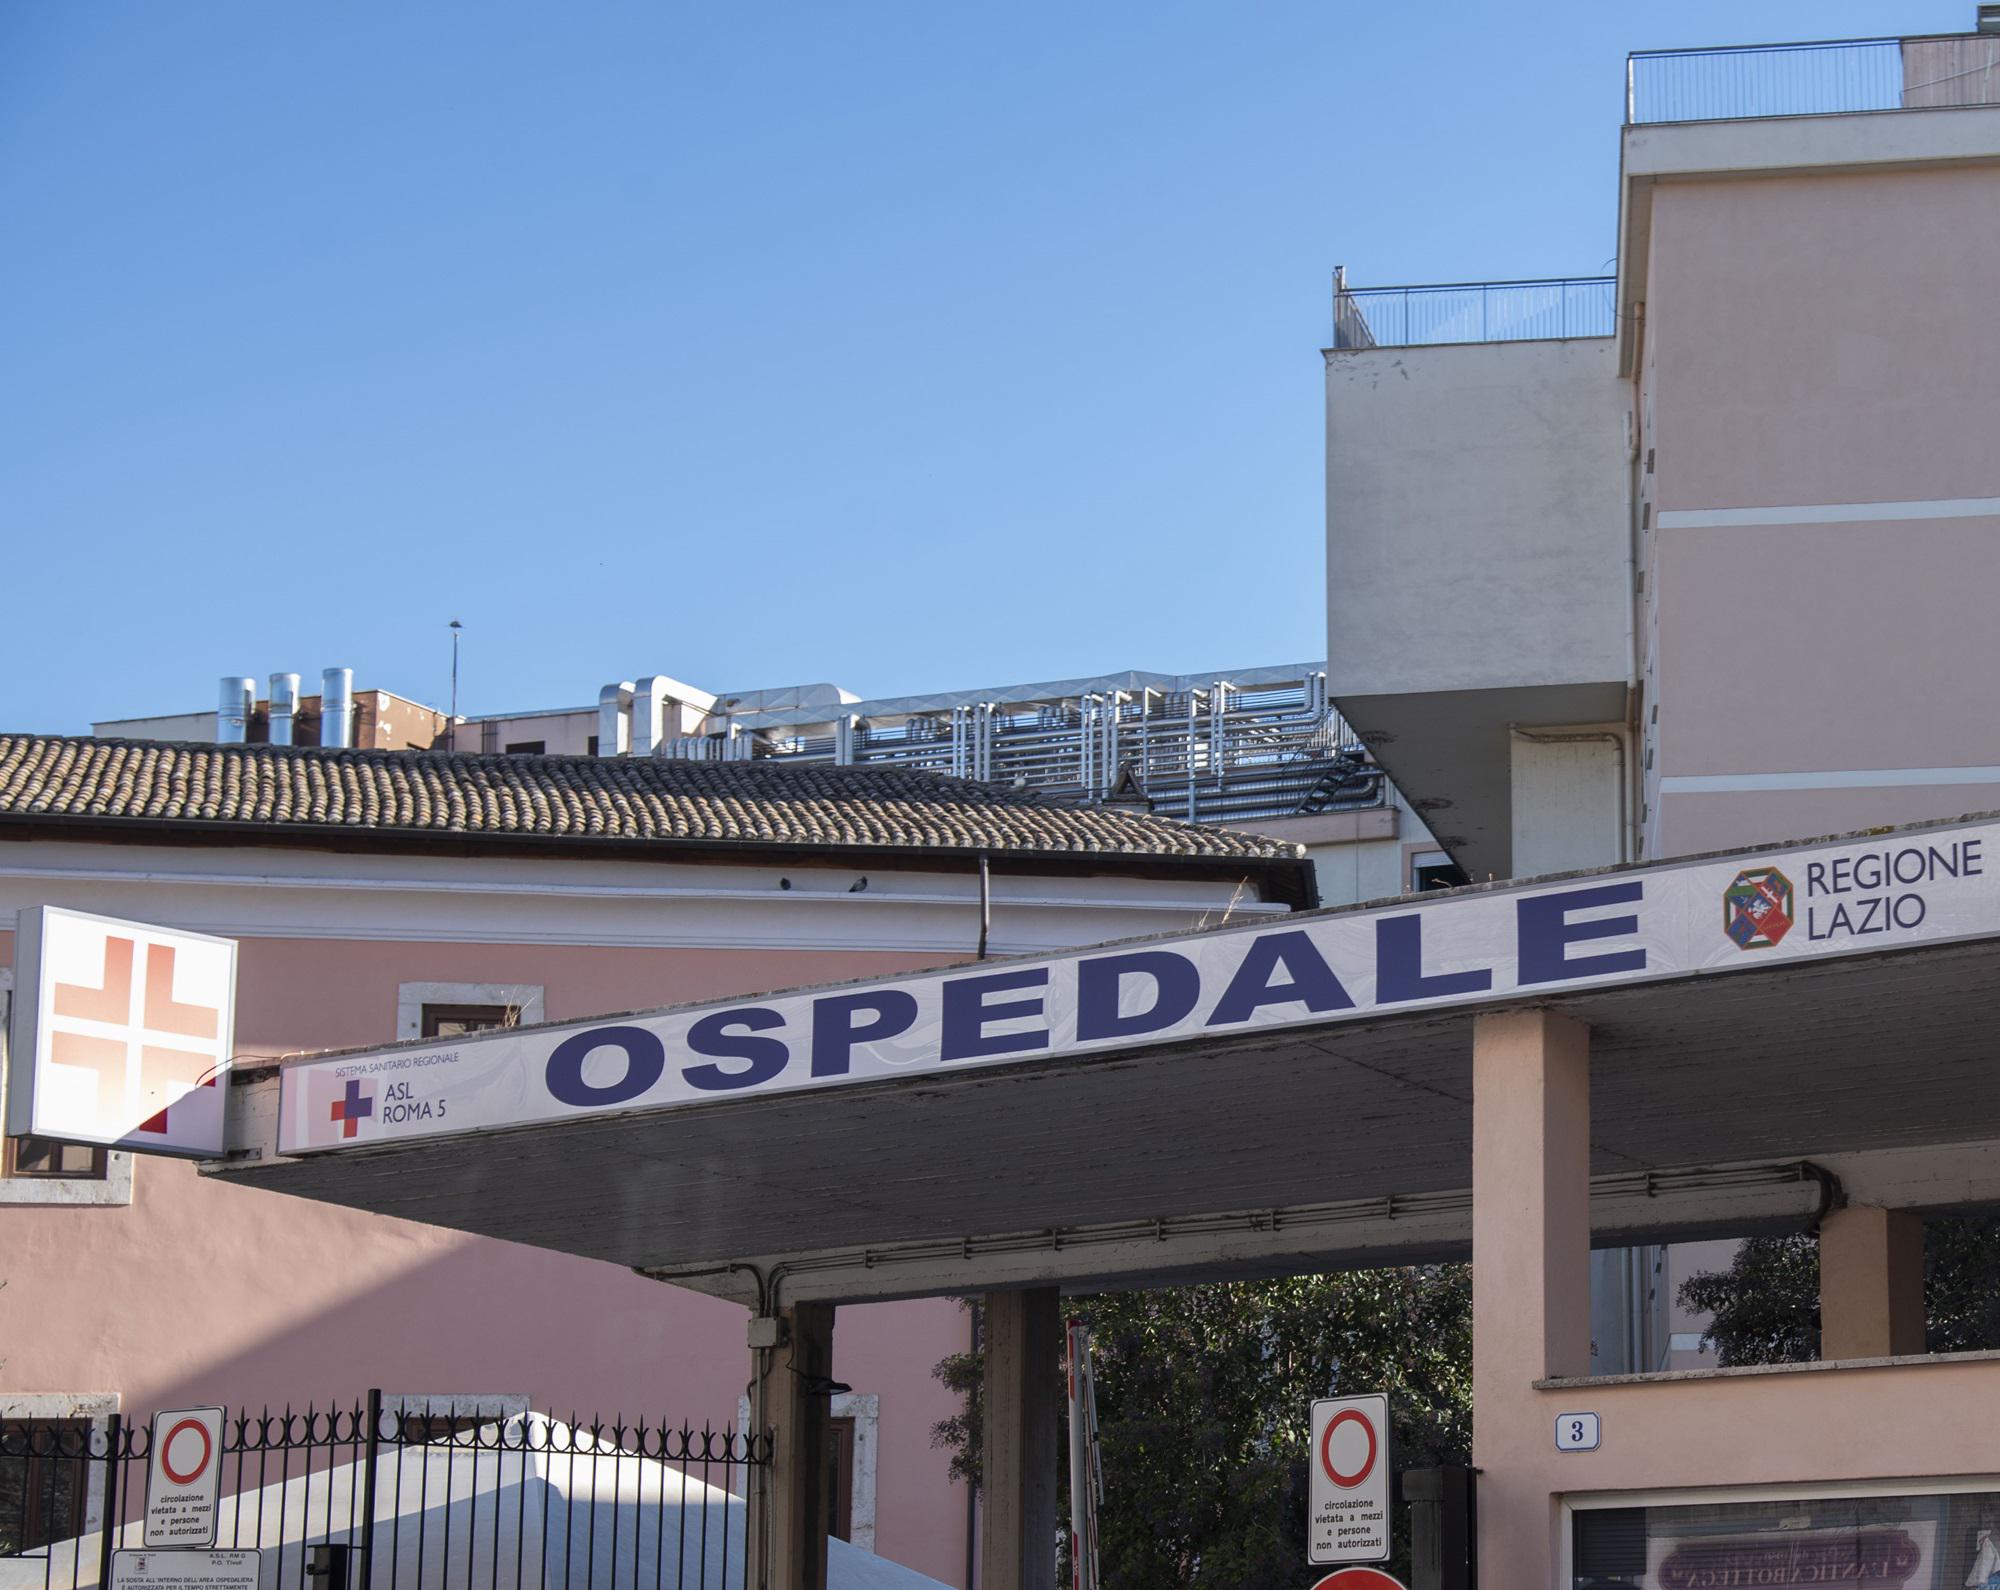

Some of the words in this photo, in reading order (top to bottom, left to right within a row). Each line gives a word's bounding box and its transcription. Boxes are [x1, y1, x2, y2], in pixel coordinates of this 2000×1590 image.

[1807, 840, 1983, 897] REGIONE
[1808, 894, 1926, 941] LAZIO
[544, 880, 1648, 1108] OSPEDALE
[335, 1065, 367, 1078] SISTEMA
[369, 1059, 412, 1073] SANITARIO
[413, 1052, 459, 1067] REGIONALE
[384, 1082, 413, 1102] ASL
[383, 1103, 433, 1124] ROMA
[438, 1099, 446, 1117] 5
[1571, 1420, 1584, 1442] 3
[160, 1494, 204, 1503] circolazione
[1324, 1499, 1374, 1510] circolazione
[151, 1506, 176, 1515] vietata
[192, 1504, 211, 1512] mezzi
[170, 1517, 199, 1527] persone
[1315, 1513, 1344, 1524] vietata
[1350, 1514, 1355, 1522] a
[1361, 1510, 1383, 1521] mezzi
[150, 1529, 164, 1537] non
[169, 1526, 208, 1536] autorizzati
[1338, 1526, 1371, 1537] persone
[1316, 1541, 1332, 1550] non
[1338, 1537, 1382, 1548] autorizzati
